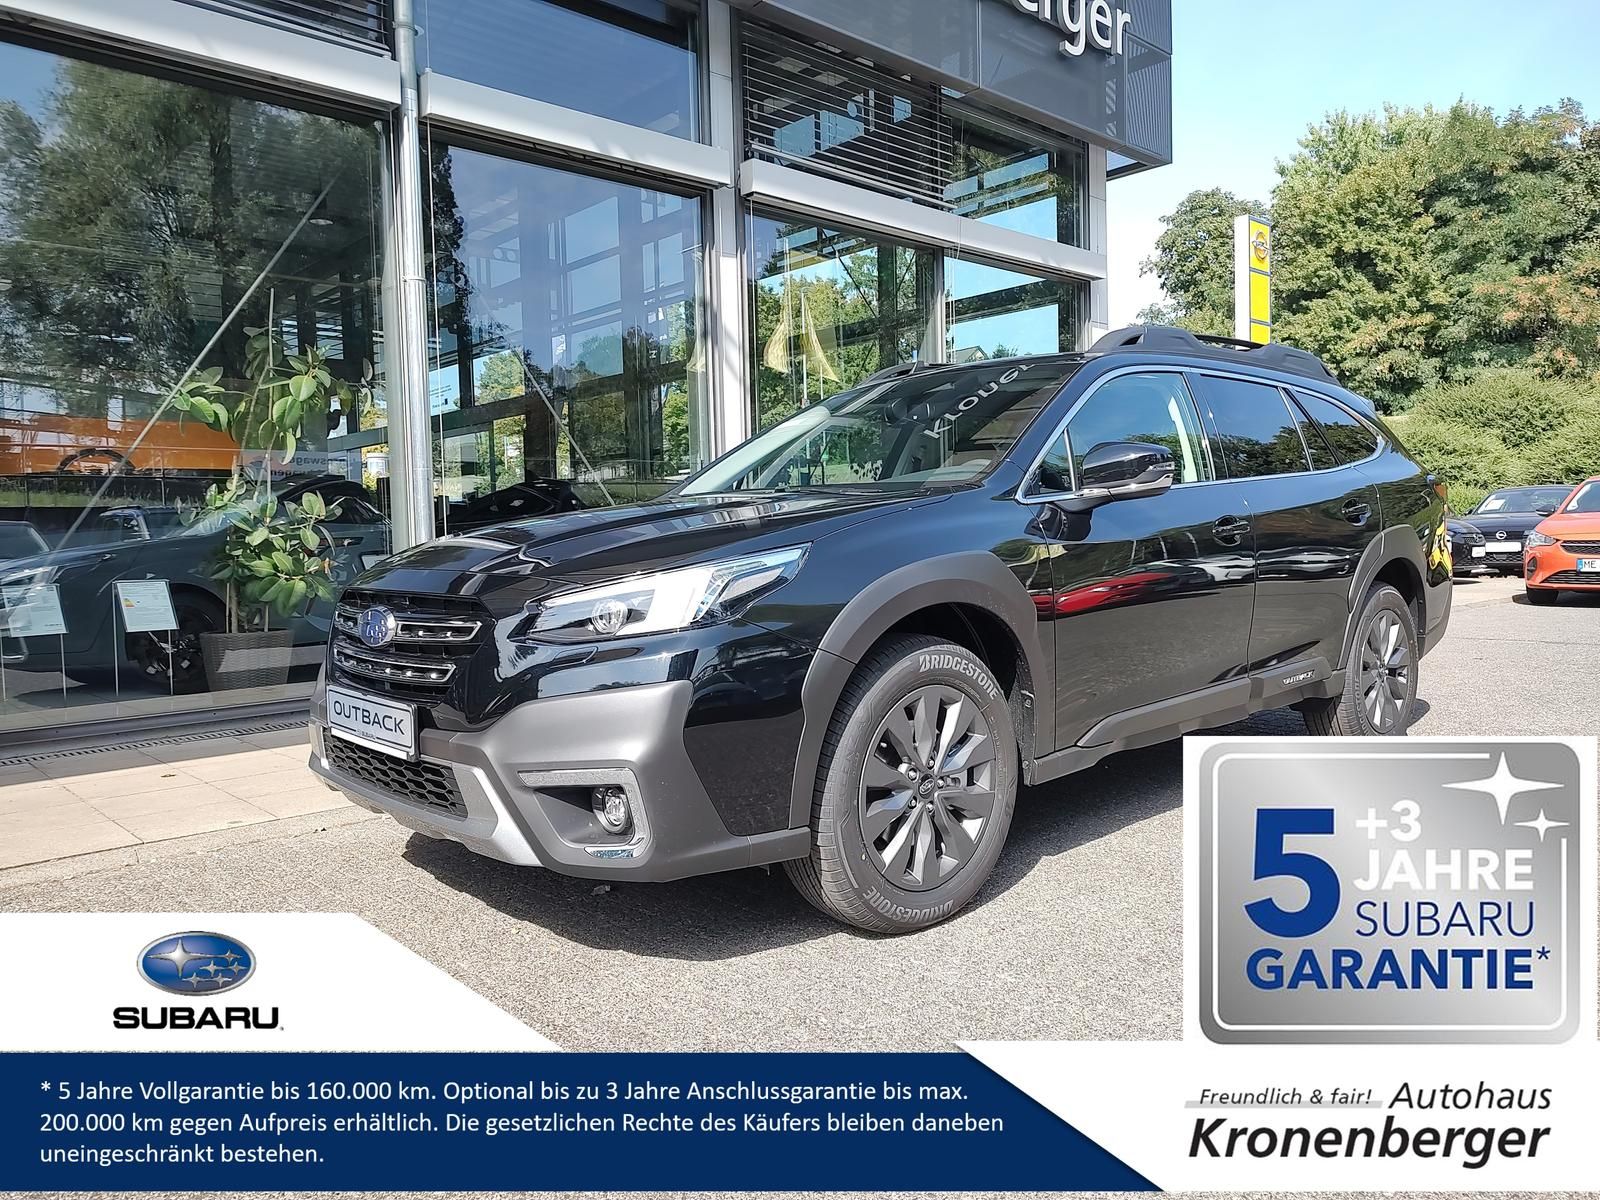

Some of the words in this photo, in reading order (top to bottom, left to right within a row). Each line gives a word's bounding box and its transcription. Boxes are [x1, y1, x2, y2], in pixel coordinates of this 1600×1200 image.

[1016, 0, 1131, 56] ger
[919, 654, 1000, 700] BRIDGESTONE
[333, 700, 406, 736] OUTBACK
